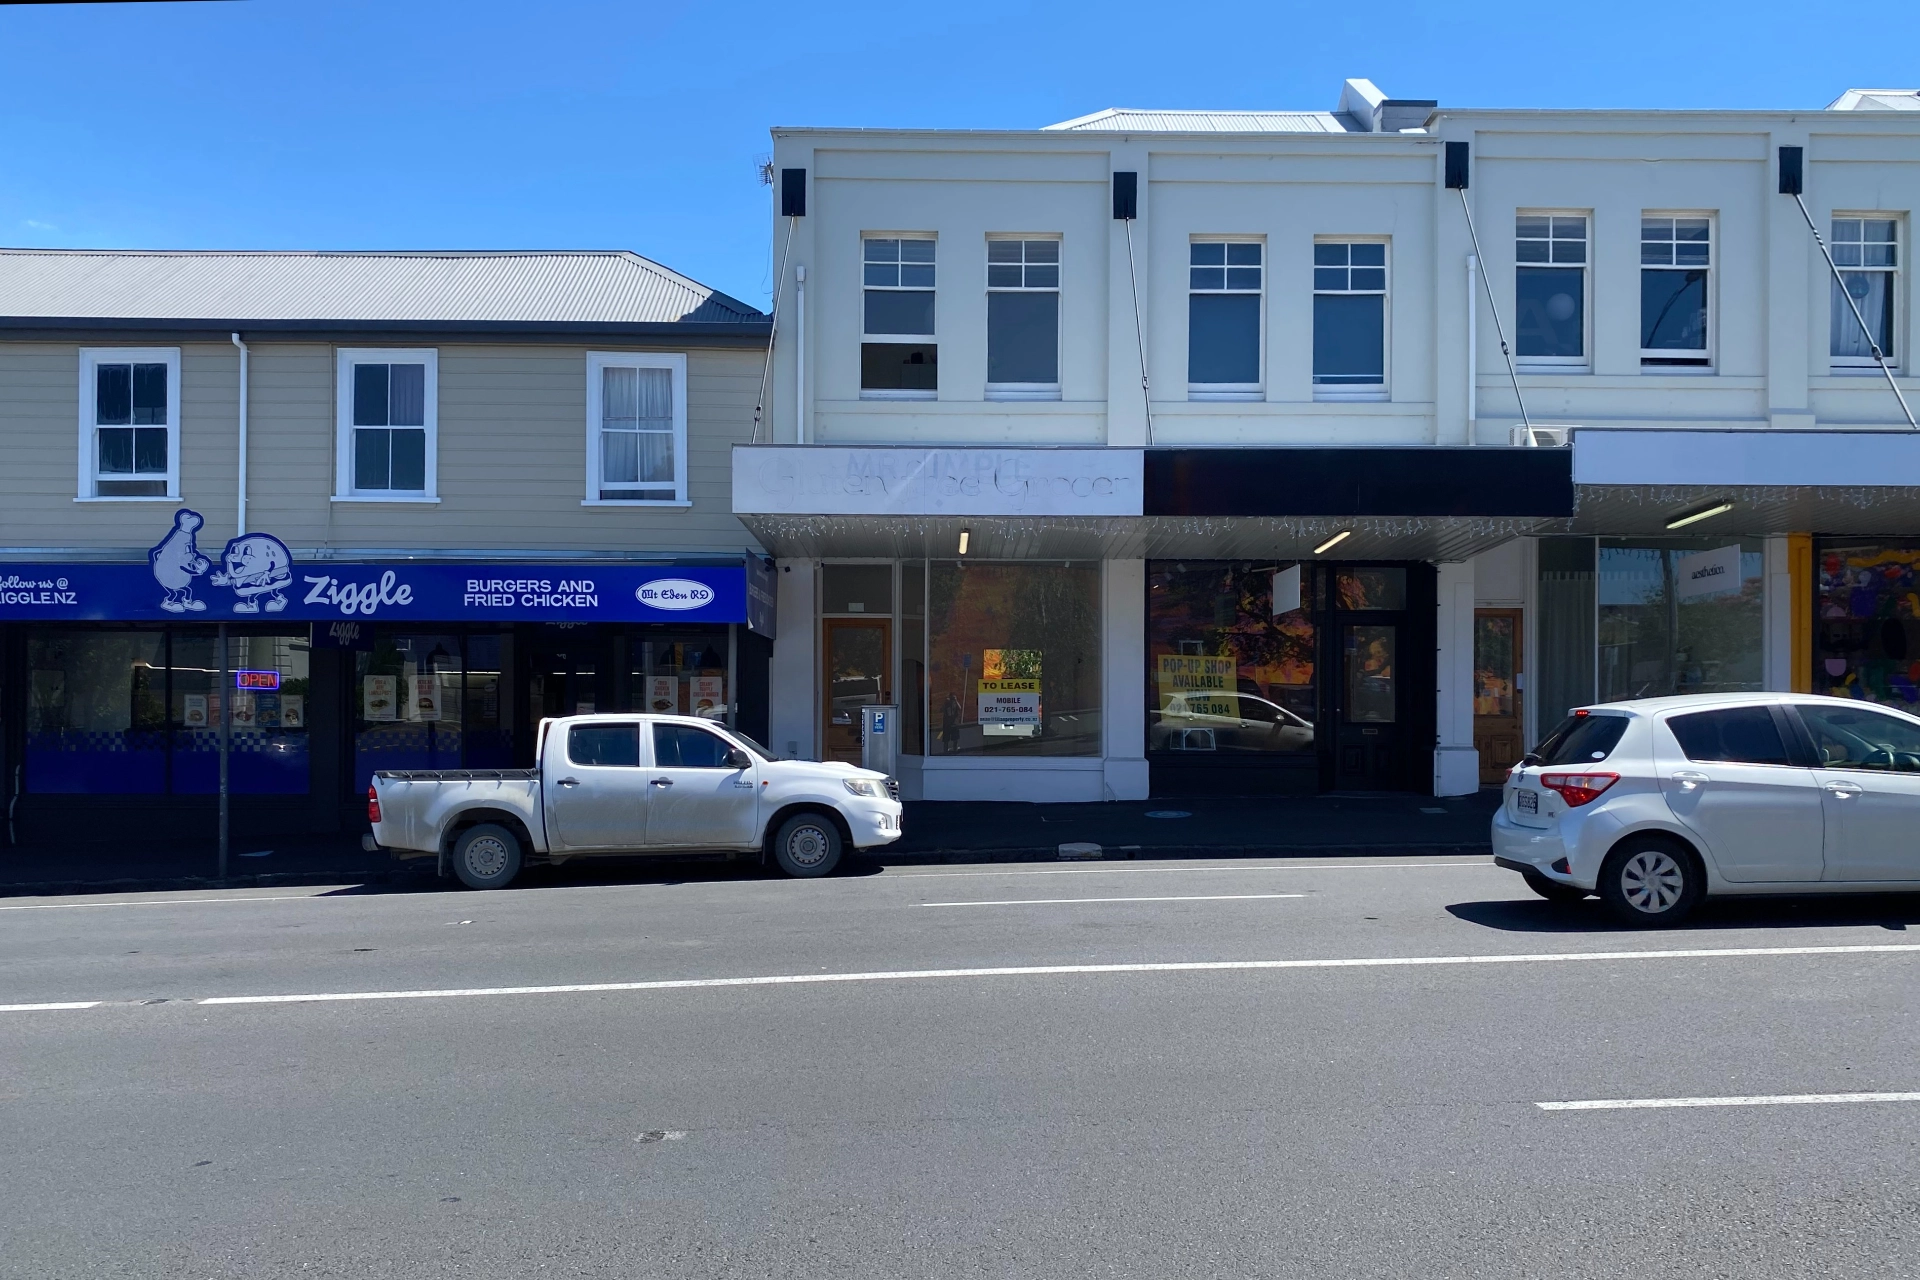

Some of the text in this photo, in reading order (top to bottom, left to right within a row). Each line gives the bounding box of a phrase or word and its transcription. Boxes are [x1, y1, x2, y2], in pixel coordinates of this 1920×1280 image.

[38, 580, 54, 589] us
[56, 577, 68, 590] @
[467, 579, 595, 593] BURGERS AND
[0, 592, 78, 604] IGGLE.NZ
[303, 570, 414, 614] Ziggle
[641, 588, 709, 600] Mt Eden RD
[464, 594, 598, 607] FRIED CHICKEN
[1163, 658, 1232, 675] POP-UP SHOP
[239, 672, 277, 687] OPEN
[983, 682, 1035, 690] TO LEASE
[1172, 674, 1224, 688] AVAILABLE
[1189, 703, 1209, 714] 765
[1211, 704, 1230, 714] 084
[875, 712, 884, 723] P
